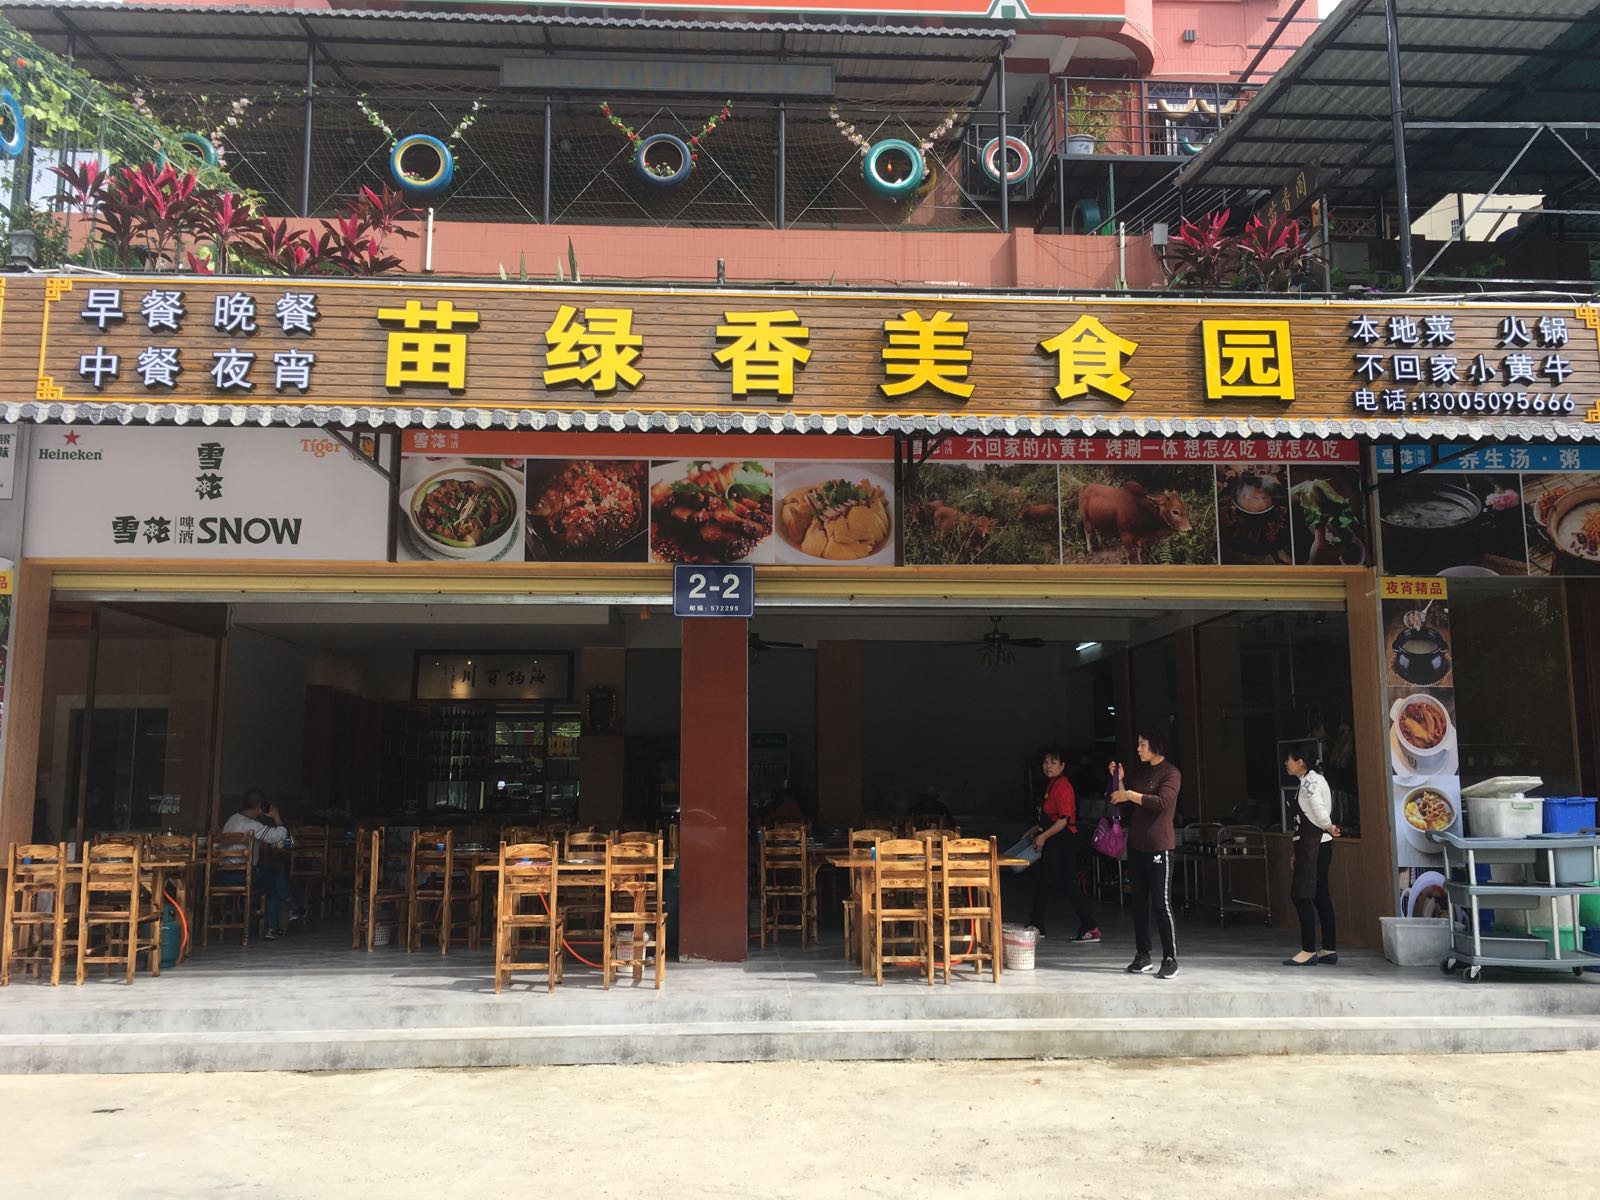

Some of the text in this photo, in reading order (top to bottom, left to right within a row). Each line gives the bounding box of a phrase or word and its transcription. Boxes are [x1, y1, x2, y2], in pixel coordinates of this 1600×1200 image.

[81, 288, 318, 333] 早餐 晚餐
[1352, 315, 1569, 344] 本地菜 火锅
[377, 300, 1296, 402] 苗绿香美食园
[80, 346, 316, 389] 中餐 夜宵
[1356, 353, 1573, 383] 不回家小黄牛
[39, 448, 102, 461] Heineken
[301, 438, 342, 458] Tiger
[966, 437, 1341, 459] 不回家的小黄牛 烤涮一体 想怎么吃 就怎么吃
[194, 442, 225, 501] 雪花
[112, 515, 302, 545] 雪花 啤酒 SNOW
[688, 573, 740, 599] 2-2
[1385, 581, 1443, 595] 夜宵精品
